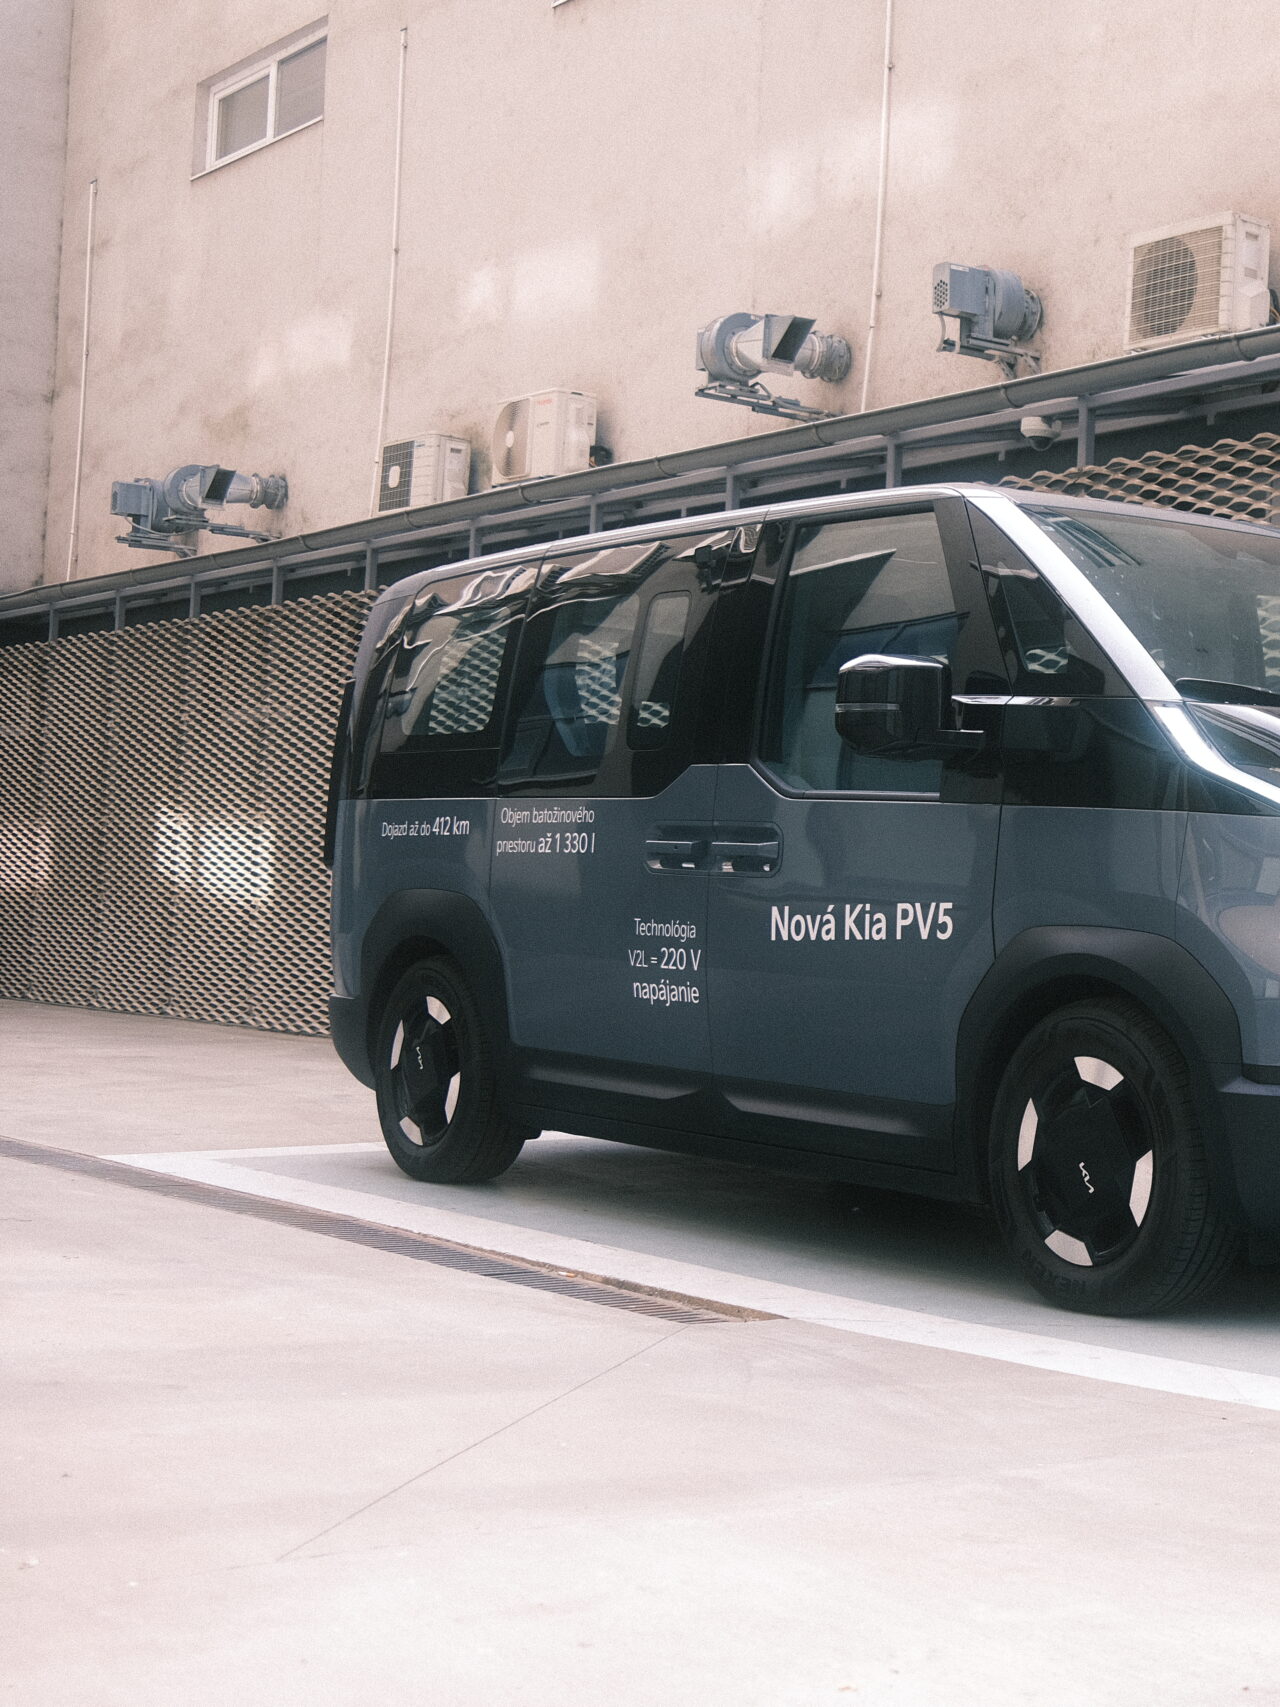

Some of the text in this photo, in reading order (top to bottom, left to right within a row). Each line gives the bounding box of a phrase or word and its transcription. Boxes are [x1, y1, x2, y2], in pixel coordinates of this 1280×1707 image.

[381, 815, 470, 840] Dojazd až do 412 km
[500, 806, 595, 828] Objem batožinového
[496, 837, 536, 857] priestoru
[537, 832, 553, 853] až
[633, 917, 697, 943] Technológia
[770, 902, 954, 942] Nová Kia PV5
[628, 949, 649, 968] V2L
[660, 947, 687, 970] 220
[690, 948, 702, 971] V
[633, 979, 700, 1007] napájanie
